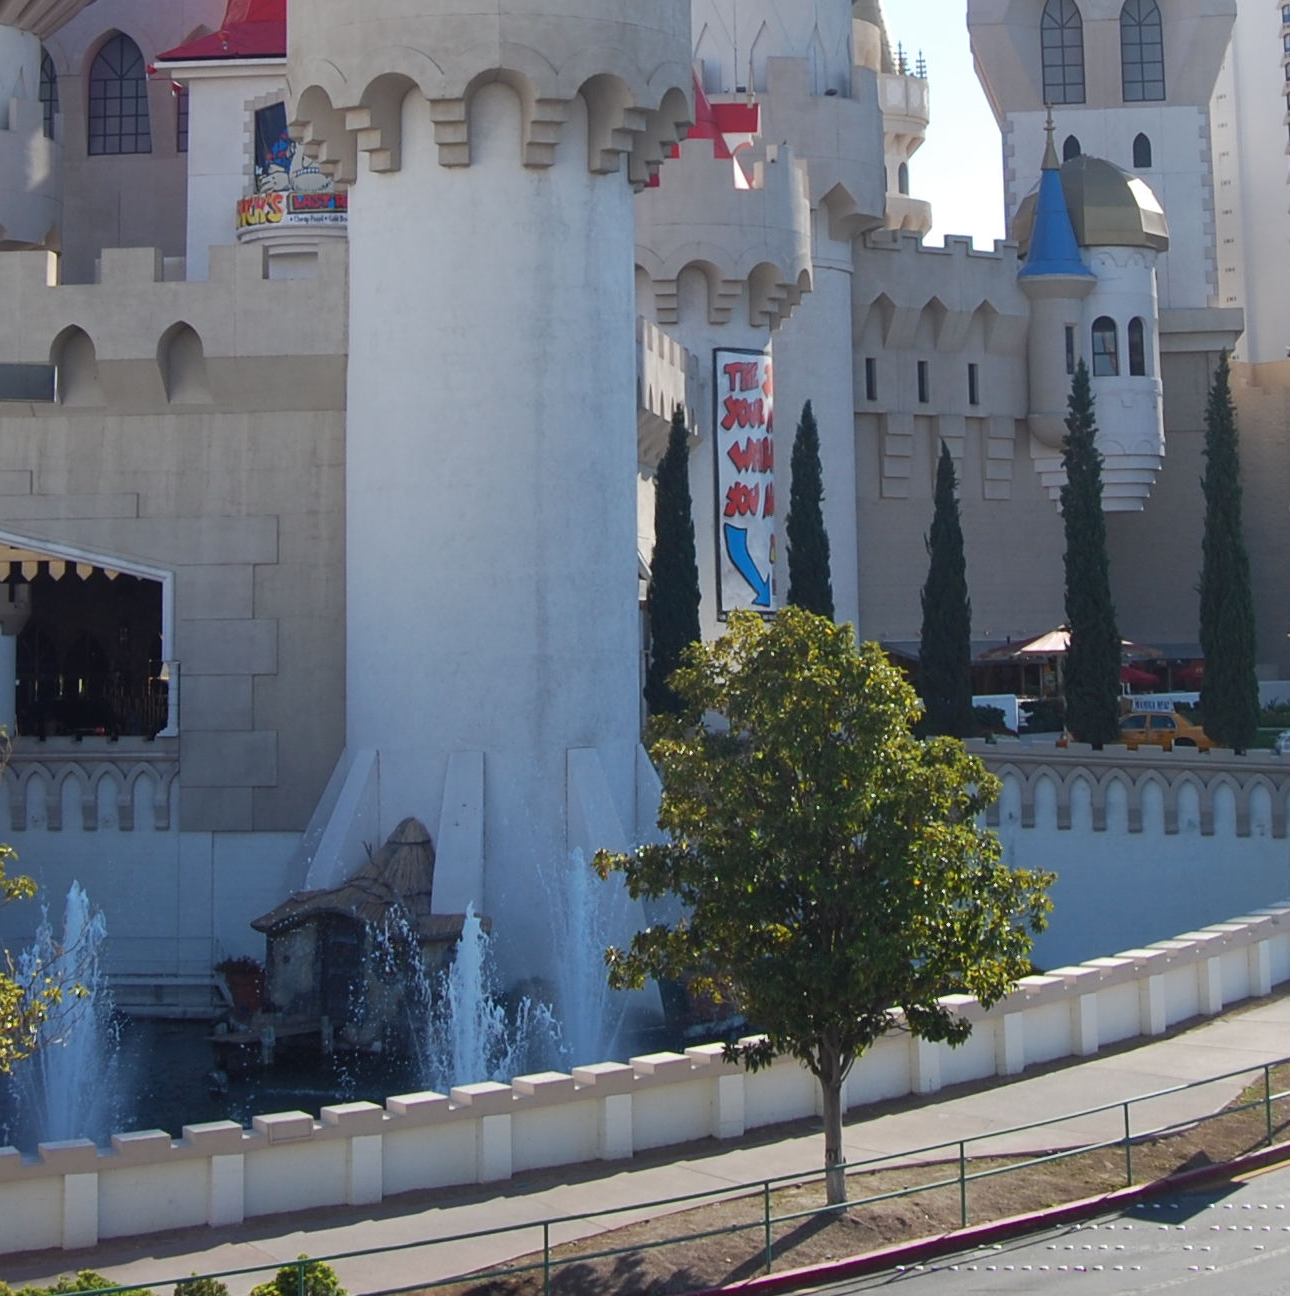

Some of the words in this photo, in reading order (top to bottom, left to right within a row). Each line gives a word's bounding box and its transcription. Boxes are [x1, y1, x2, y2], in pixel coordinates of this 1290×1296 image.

[723, 362, 759, 392] THE
[720, 395, 765, 431] YOUR
[724, 481, 759, 517] YOU
